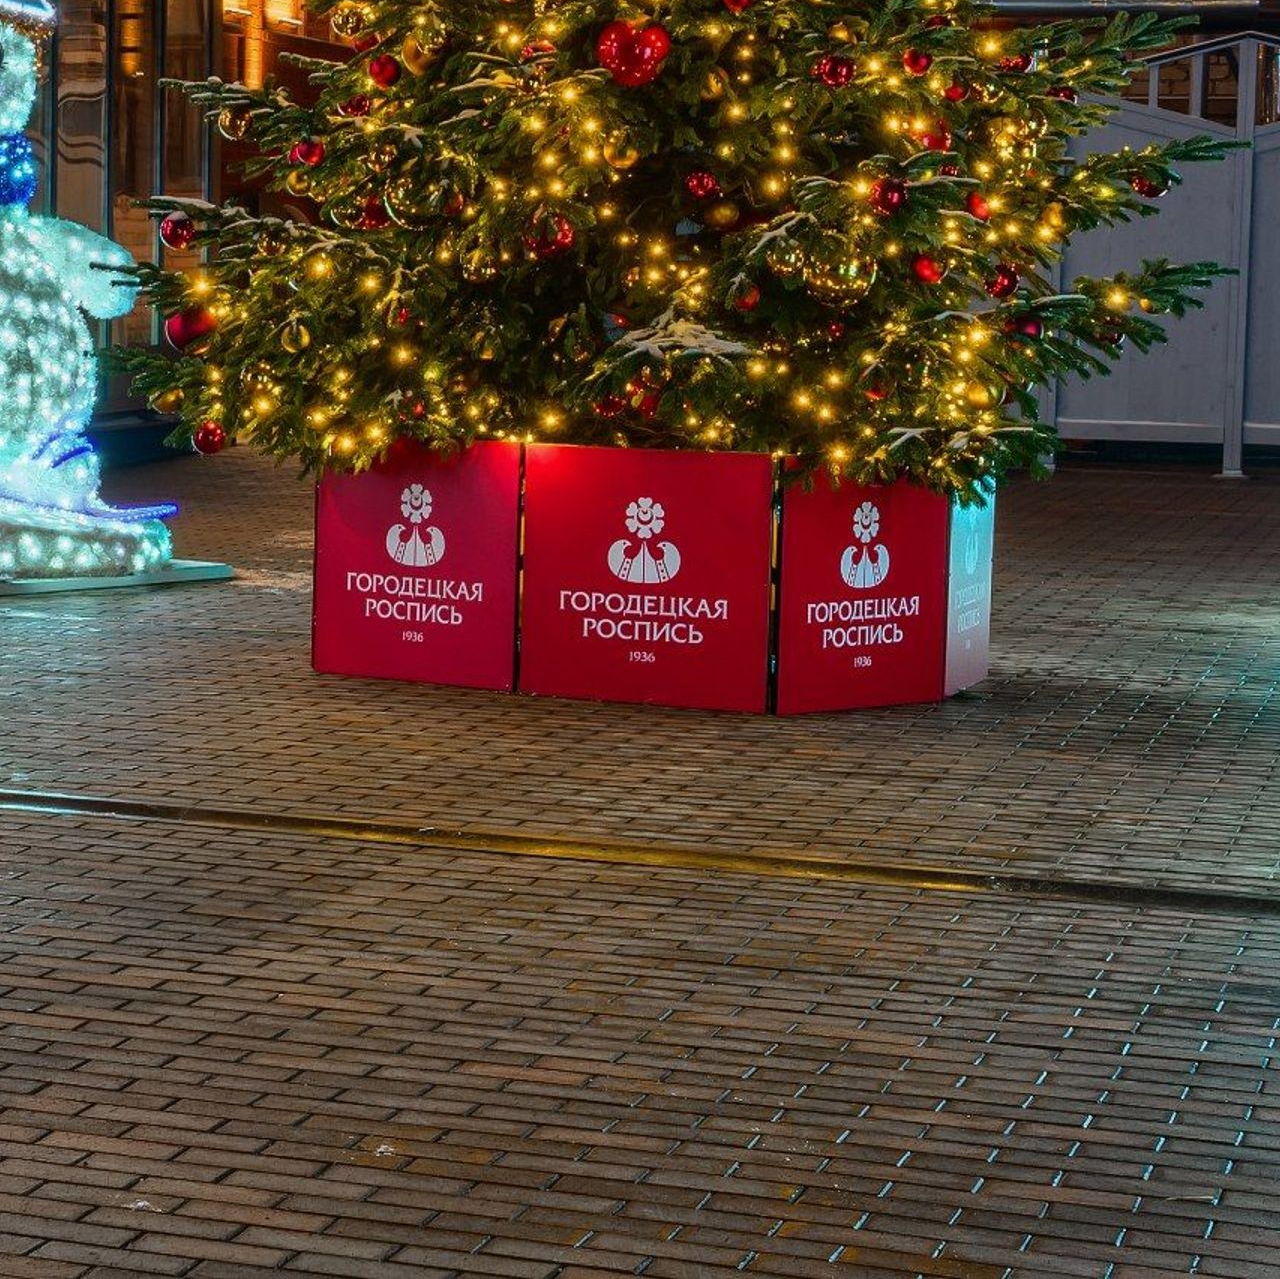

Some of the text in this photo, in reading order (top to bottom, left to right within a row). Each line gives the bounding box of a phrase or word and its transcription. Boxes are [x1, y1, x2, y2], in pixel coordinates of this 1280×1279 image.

[346, 571, 484, 602] ГОРОДЕЦКАЯ
[364, 598, 463, 625] РОСПИСЬ
[559, 590, 728, 620] ГОРОДЕЦКАЯ
[807, 595, 920, 624] ГОРОДЕЦКАЯ
[402, 630, 424, 643] 1936
[582, 617, 704, 644] РОСПИСЬ
[822, 623, 904, 649] РОСПИСЬ
[629, 651, 656, 663] 1936
[853, 655, 872, 668] 1936
